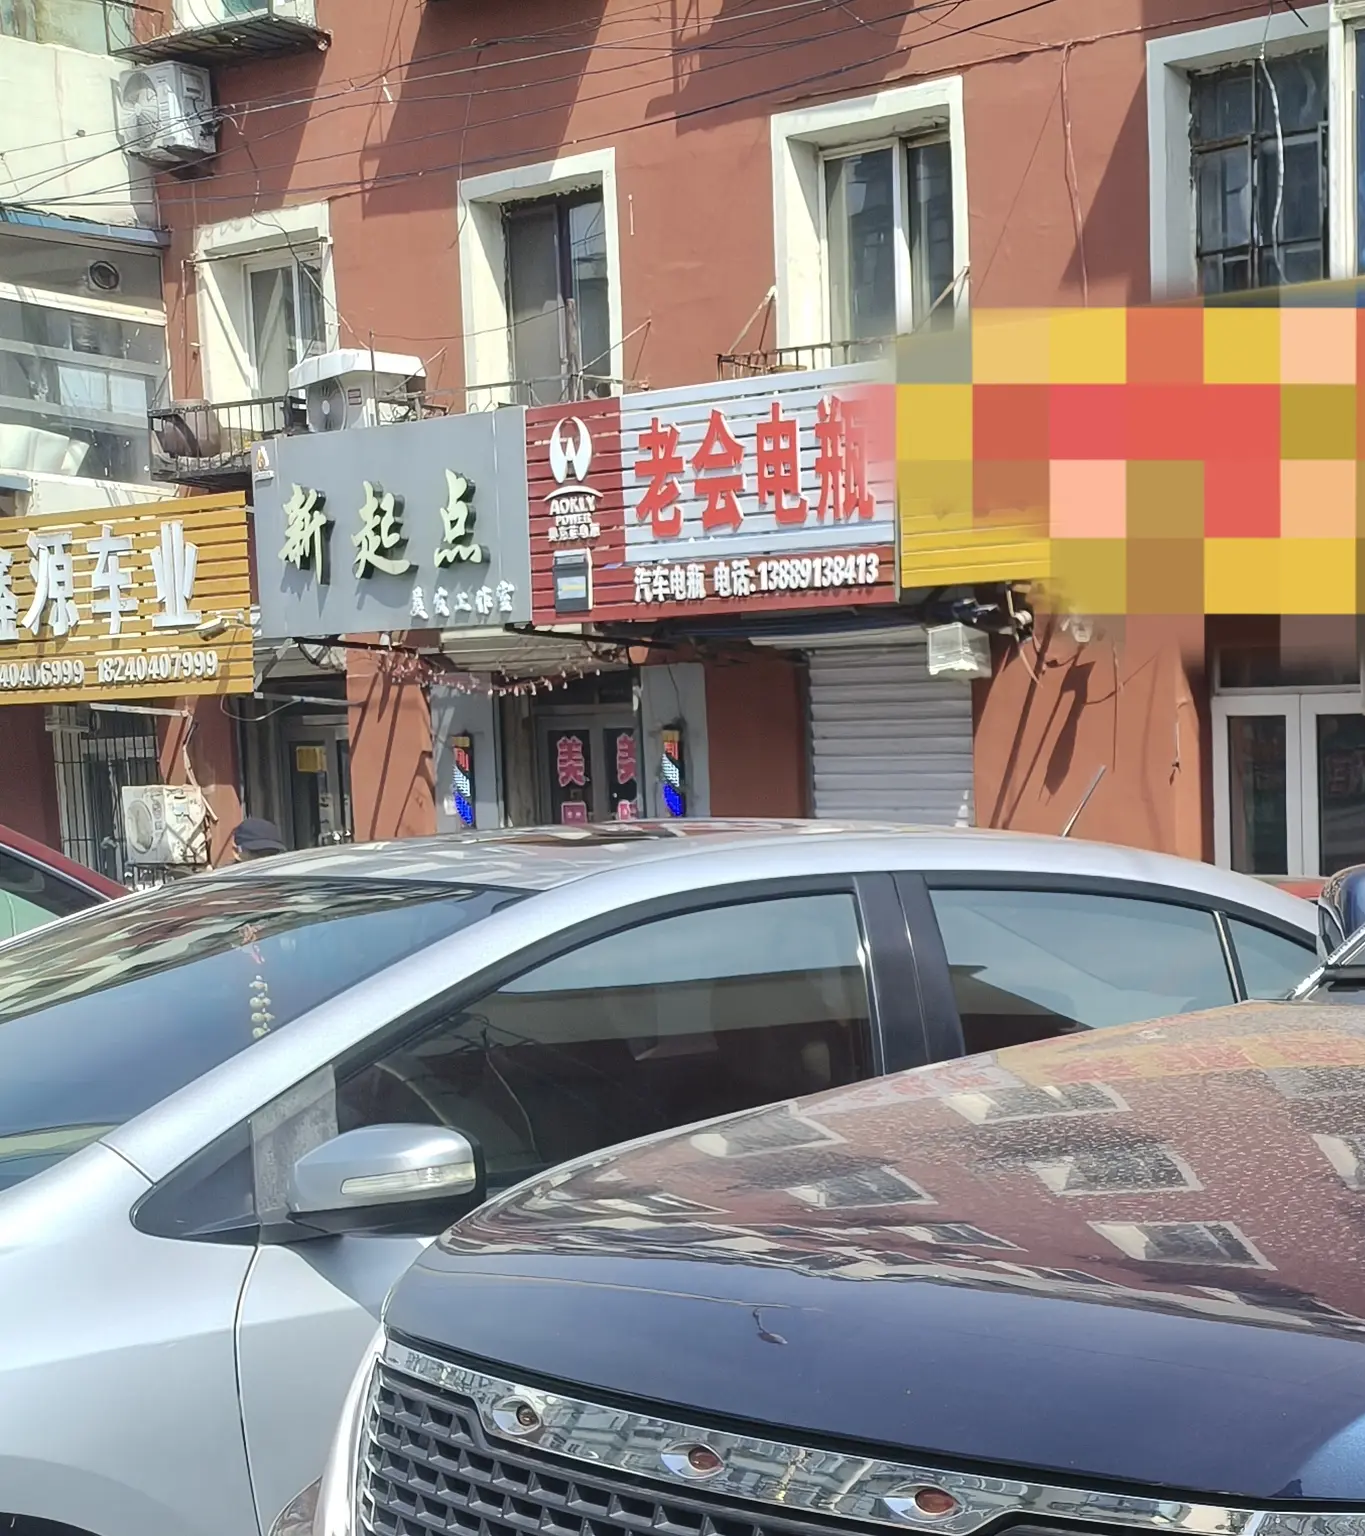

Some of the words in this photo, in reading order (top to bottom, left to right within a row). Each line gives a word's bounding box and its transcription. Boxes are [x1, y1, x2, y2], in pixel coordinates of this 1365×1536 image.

[634, 395, 876, 538] 老会电瓶
[549, 495, 596, 516] AOKLY
[555, 512, 593, 527] POWER
[278, 467, 487, 585] 新起点
[633, 562, 707, 603] 汽车电瓶
[96, 650, 219, 685] 18240407999
